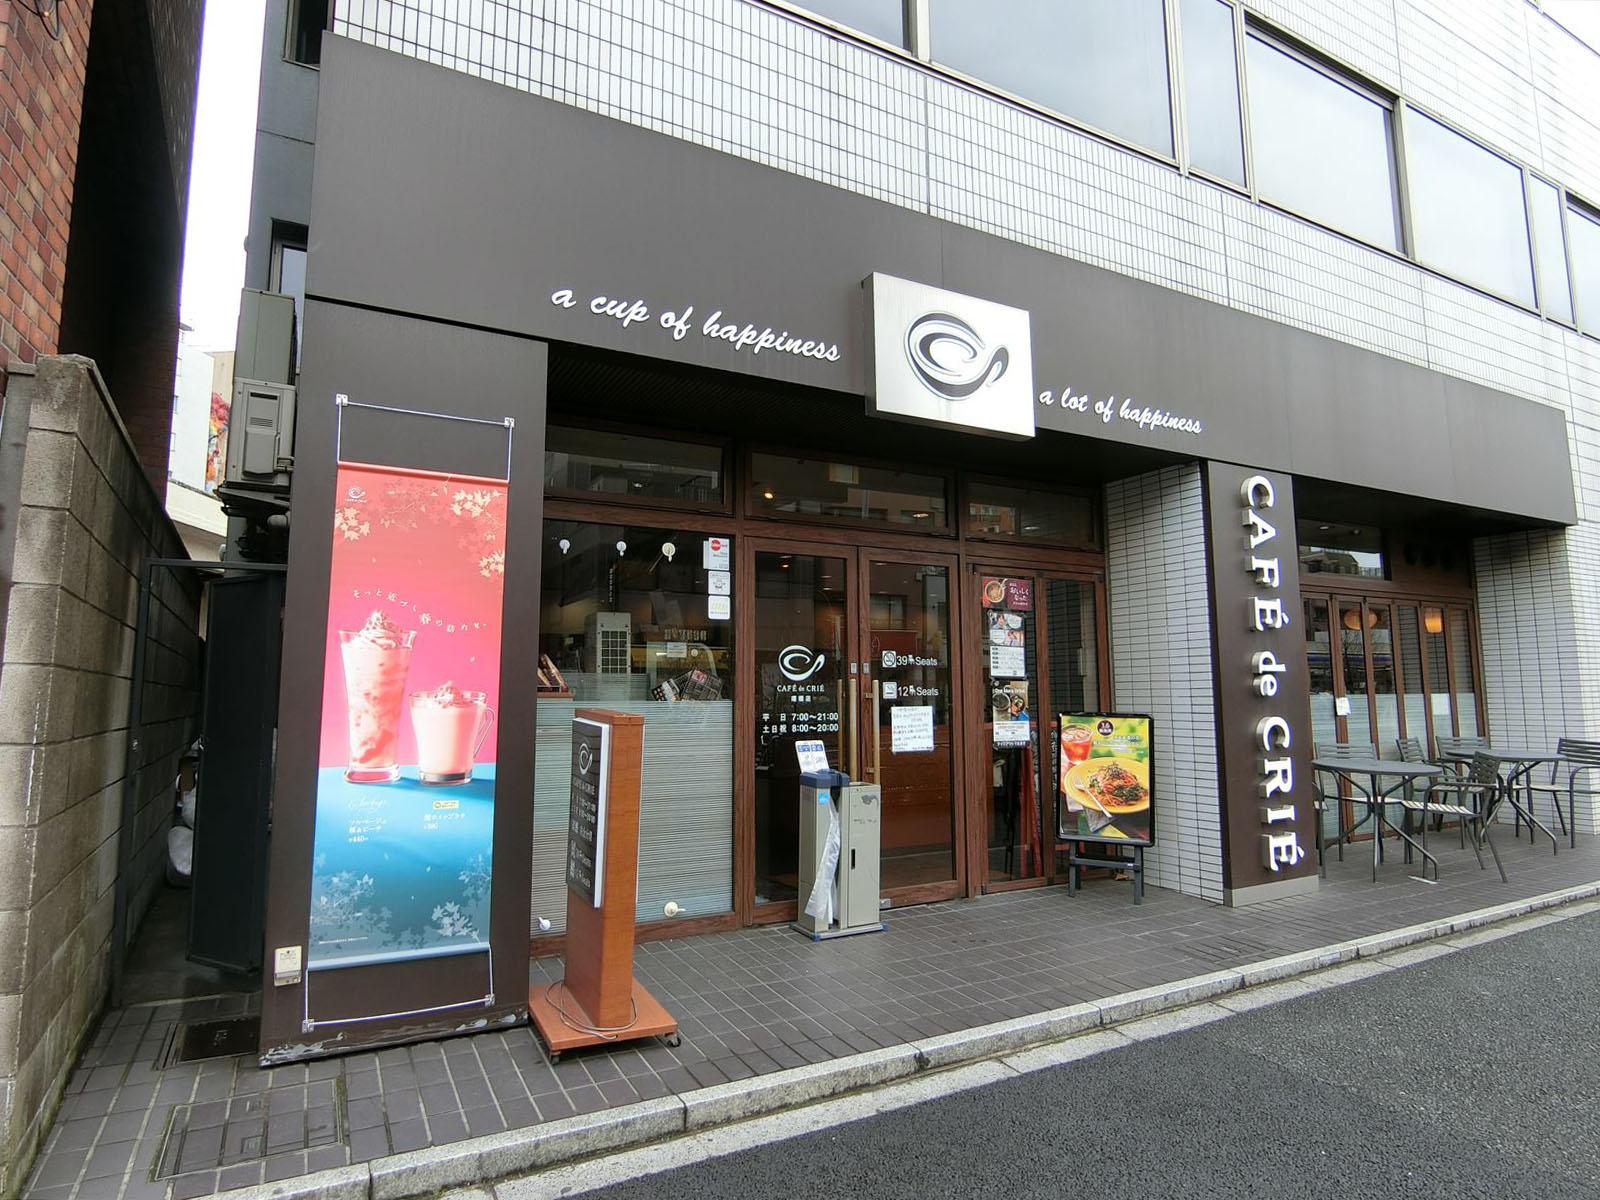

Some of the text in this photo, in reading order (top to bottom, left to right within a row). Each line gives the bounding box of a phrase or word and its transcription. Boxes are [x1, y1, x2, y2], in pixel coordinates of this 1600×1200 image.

[551, 288, 841, 362] a cup of happiness
[1039, 386, 1203, 434] a lot of happiness
[896, 656, 938, 666] 39 Seats
[1242, 474, 1305, 872] CAFÉ de CRIÉ
[777, 684, 797, 693] CAFÉ
[806, 684, 825, 693] CRIÉ
[897, 686, 939, 696] 12 Seats
